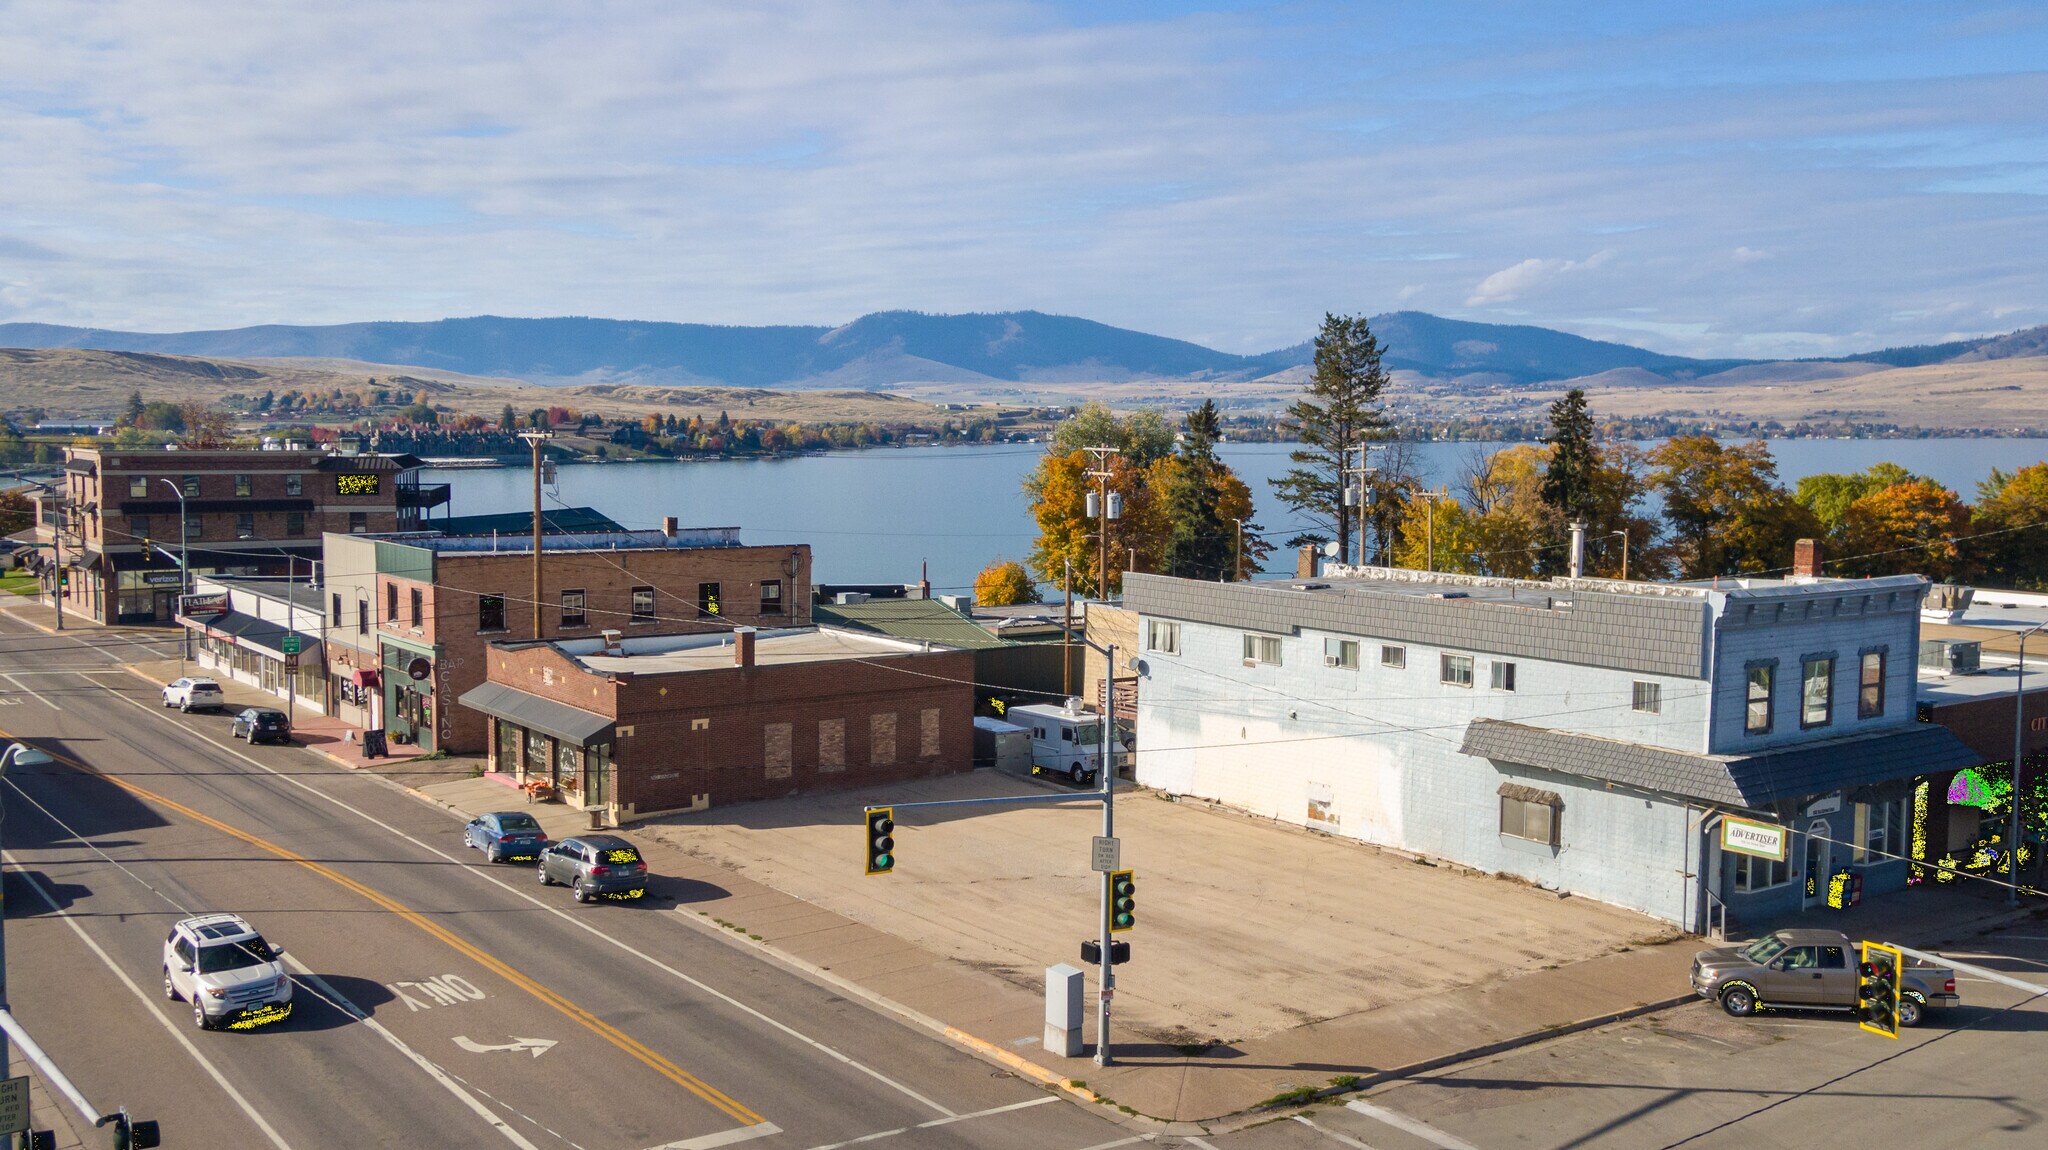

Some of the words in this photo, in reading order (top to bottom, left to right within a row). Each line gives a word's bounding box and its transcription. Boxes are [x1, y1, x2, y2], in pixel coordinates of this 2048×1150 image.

[149, 575, 179, 583] verizon
[440, 658, 464, 670] BAR
[440, 670, 453, 740] CASINO
[1098, 839, 1115, 847] RIGHT
[1729, 827, 1779, 846] ADVERTISER
[386, 974, 486, 1012] ONLY
